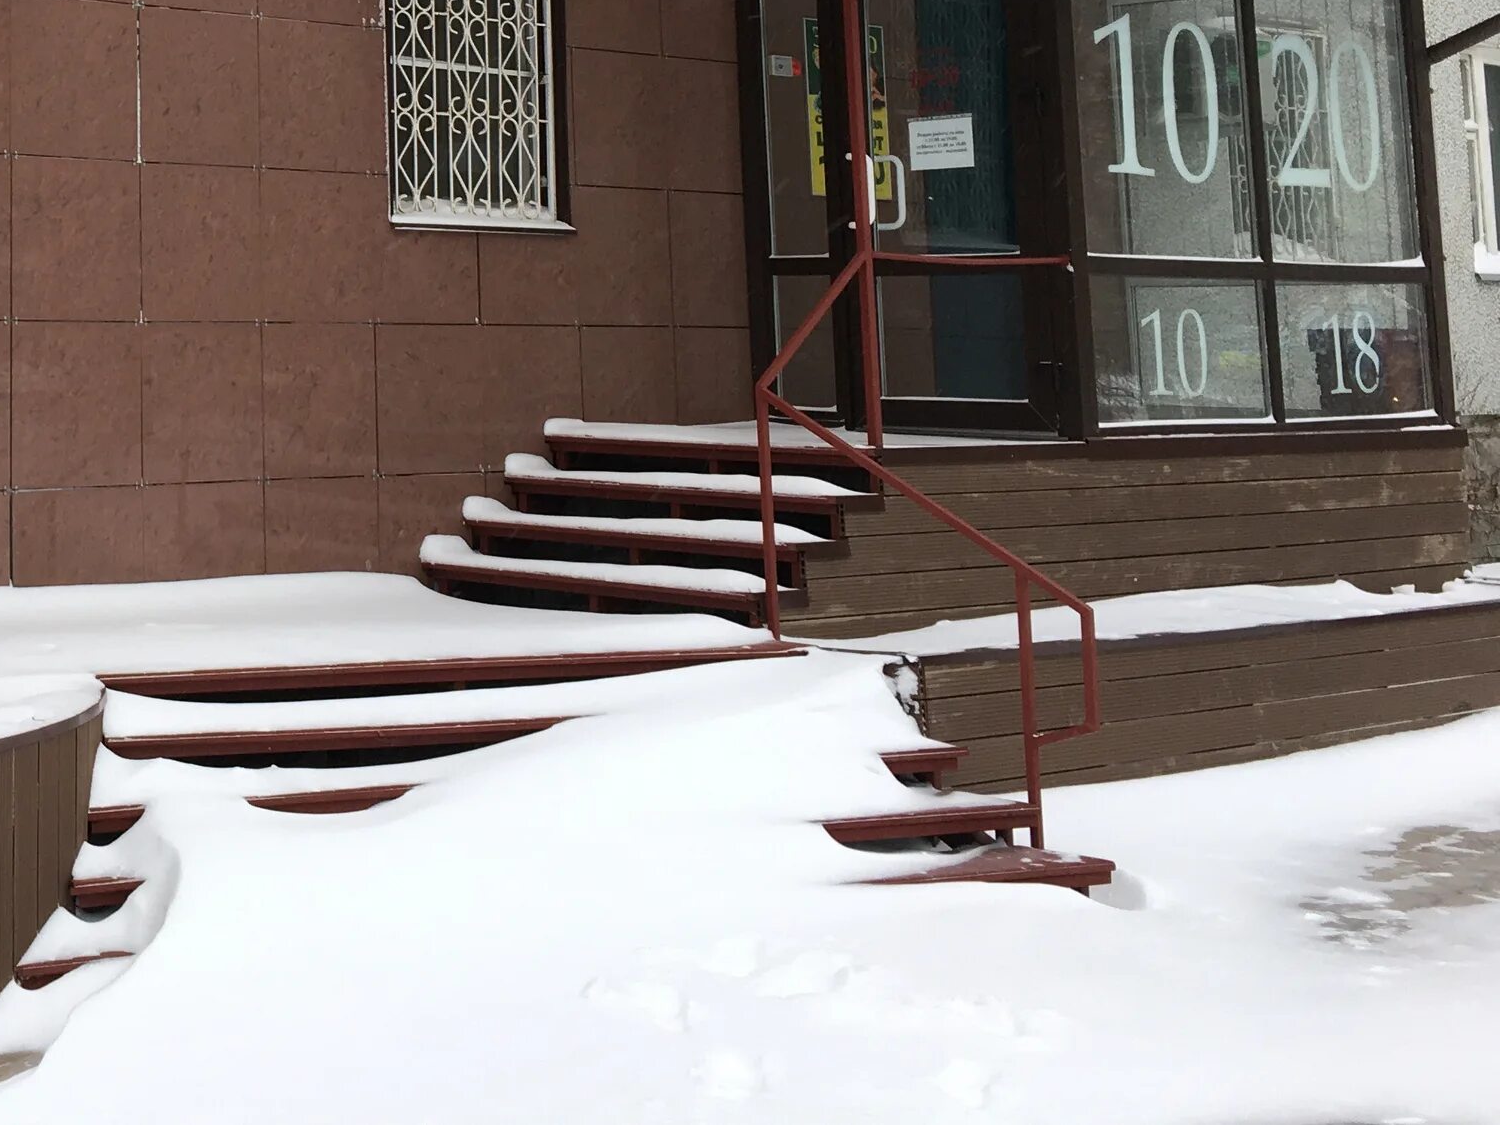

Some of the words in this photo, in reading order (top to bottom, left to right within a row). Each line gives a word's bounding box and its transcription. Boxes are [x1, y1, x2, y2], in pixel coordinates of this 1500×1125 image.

[1093, 12, 1219, 184] 10
[1271, 33, 1381, 191] 20
[1140, 308, 1208, 398] 10
[1322, 311, 1381, 395] 18
